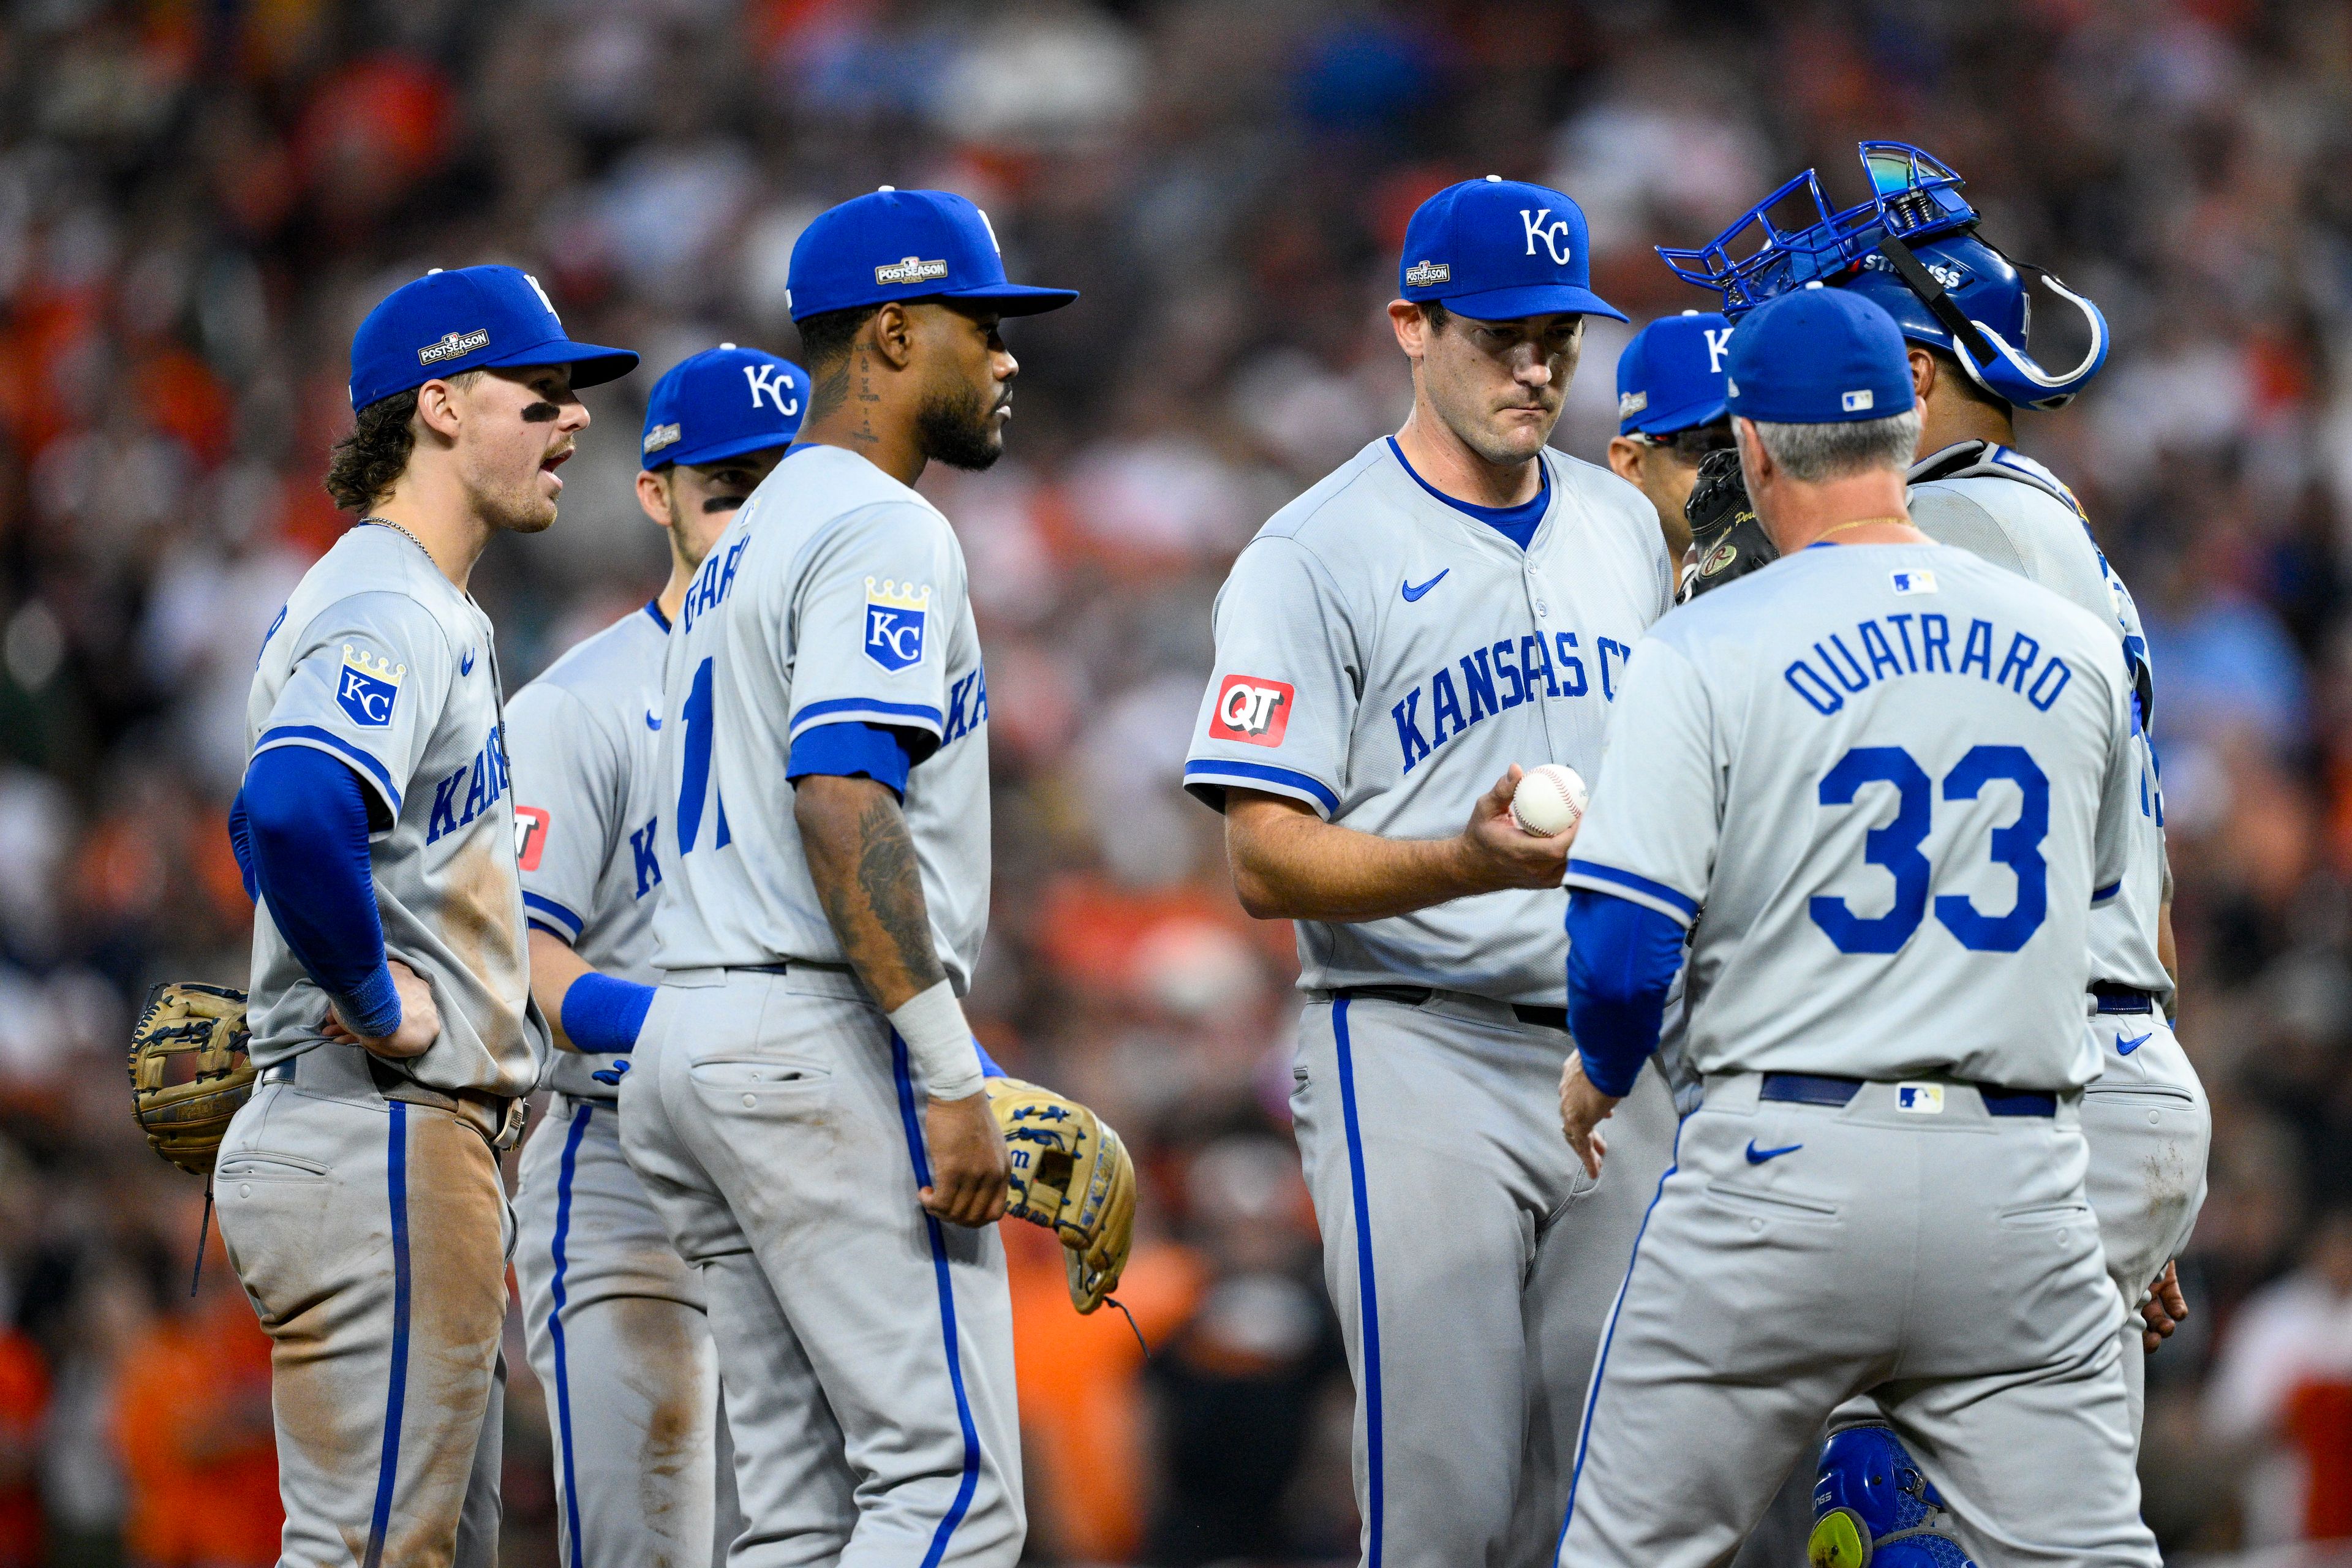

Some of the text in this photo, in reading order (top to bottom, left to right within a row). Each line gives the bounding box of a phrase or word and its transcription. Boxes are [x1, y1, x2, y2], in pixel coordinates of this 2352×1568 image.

[1520, 209, 1570, 265] KC
[878, 263, 944, 281] POSTSEASON
[1408, 268, 1447, 282] POSTSEASON
[1864, 254, 1960, 287] STSS
[421, 333, 486, 361] POSTSEASON
[446, 348, 464, 358] 2024
[744, 364, 798, 416] KC
[869, 611, 919, 660] KC
[1784, 613, 2071, 716] QUATRARO
[342, 672, 390, 722] KC
[1220, 684, 1284, 735] QT
[1391, 630, 1589, 775] KANSAS
[1809, 745, 2050, 955] 33
